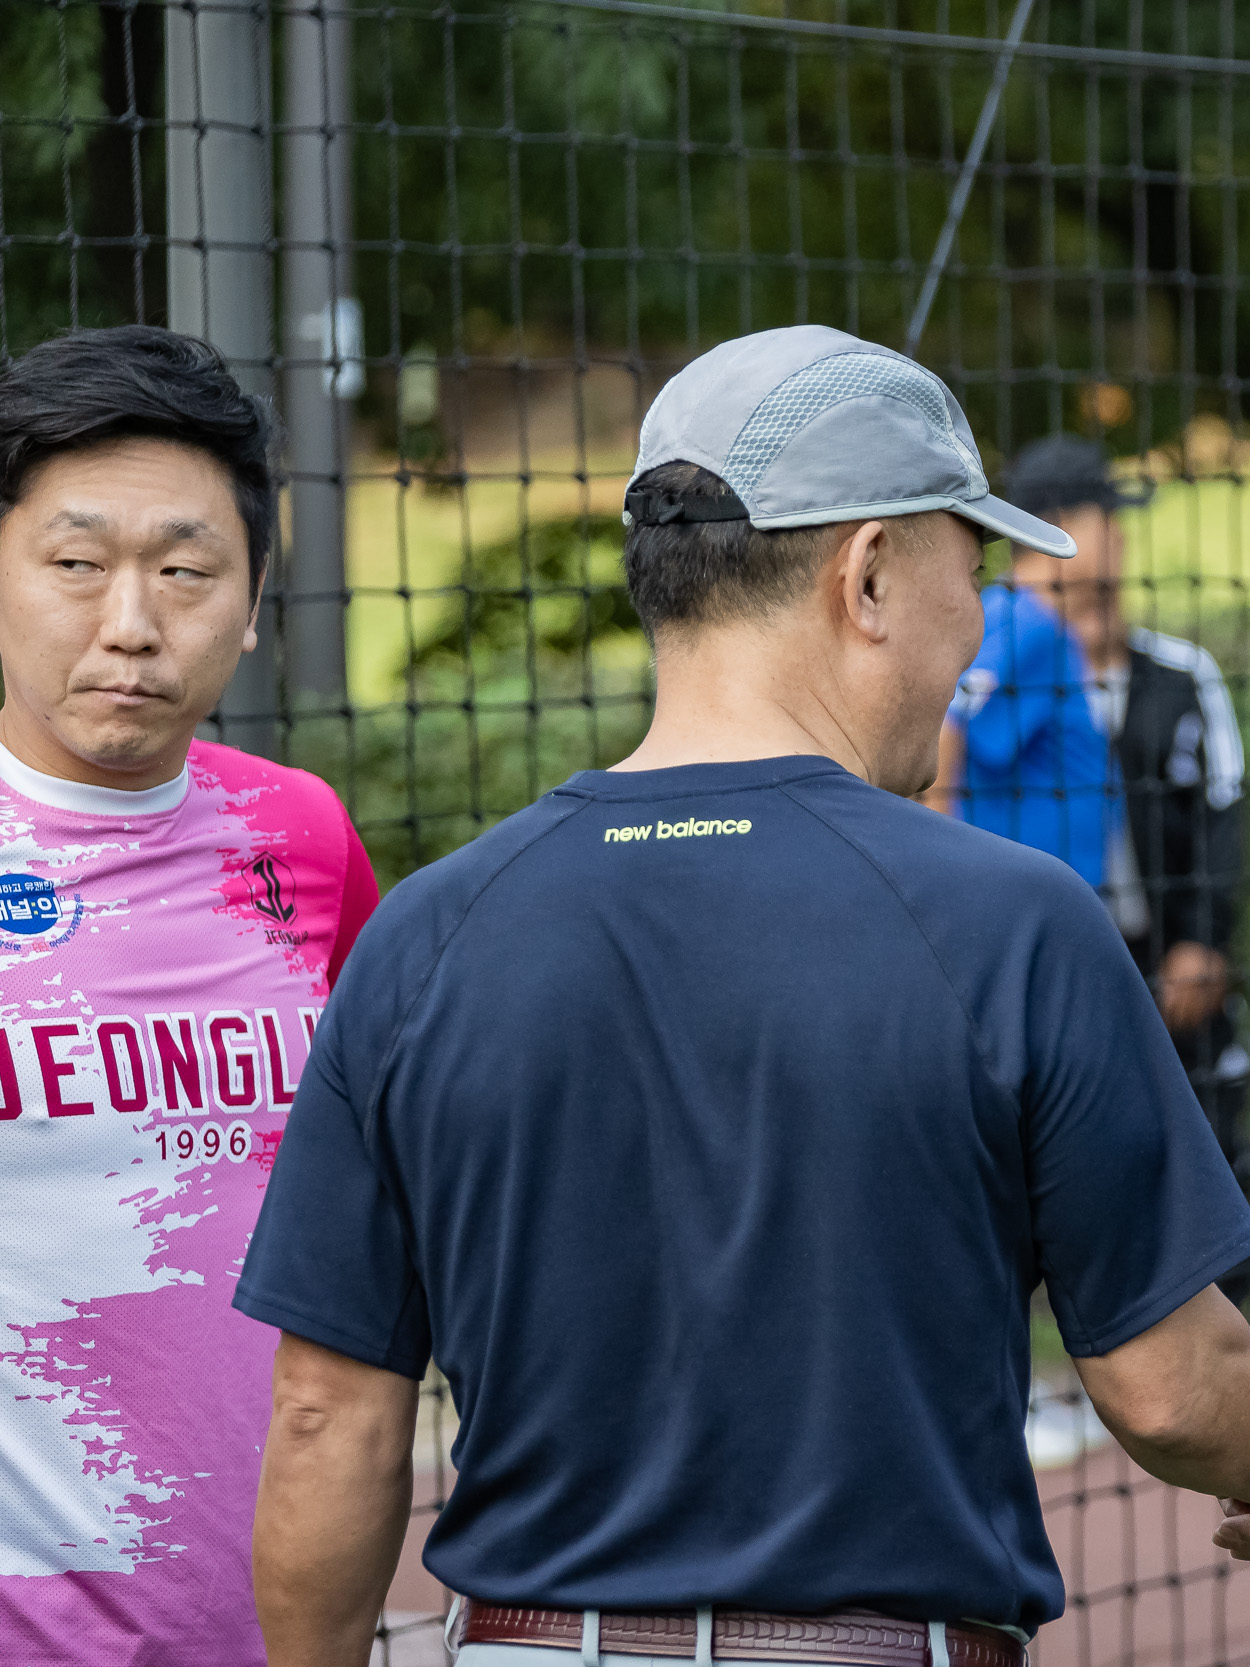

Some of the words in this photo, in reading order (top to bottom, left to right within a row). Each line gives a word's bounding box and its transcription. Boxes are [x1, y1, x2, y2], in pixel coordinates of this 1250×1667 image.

[604, 825, 653, 843] new
[656, 817, 753, 840] balance
[0, 883, 22, 895] 하고
[0, 1012, 318, 1121] JEONGL
[155, 1126, 248, 1161] 1996
